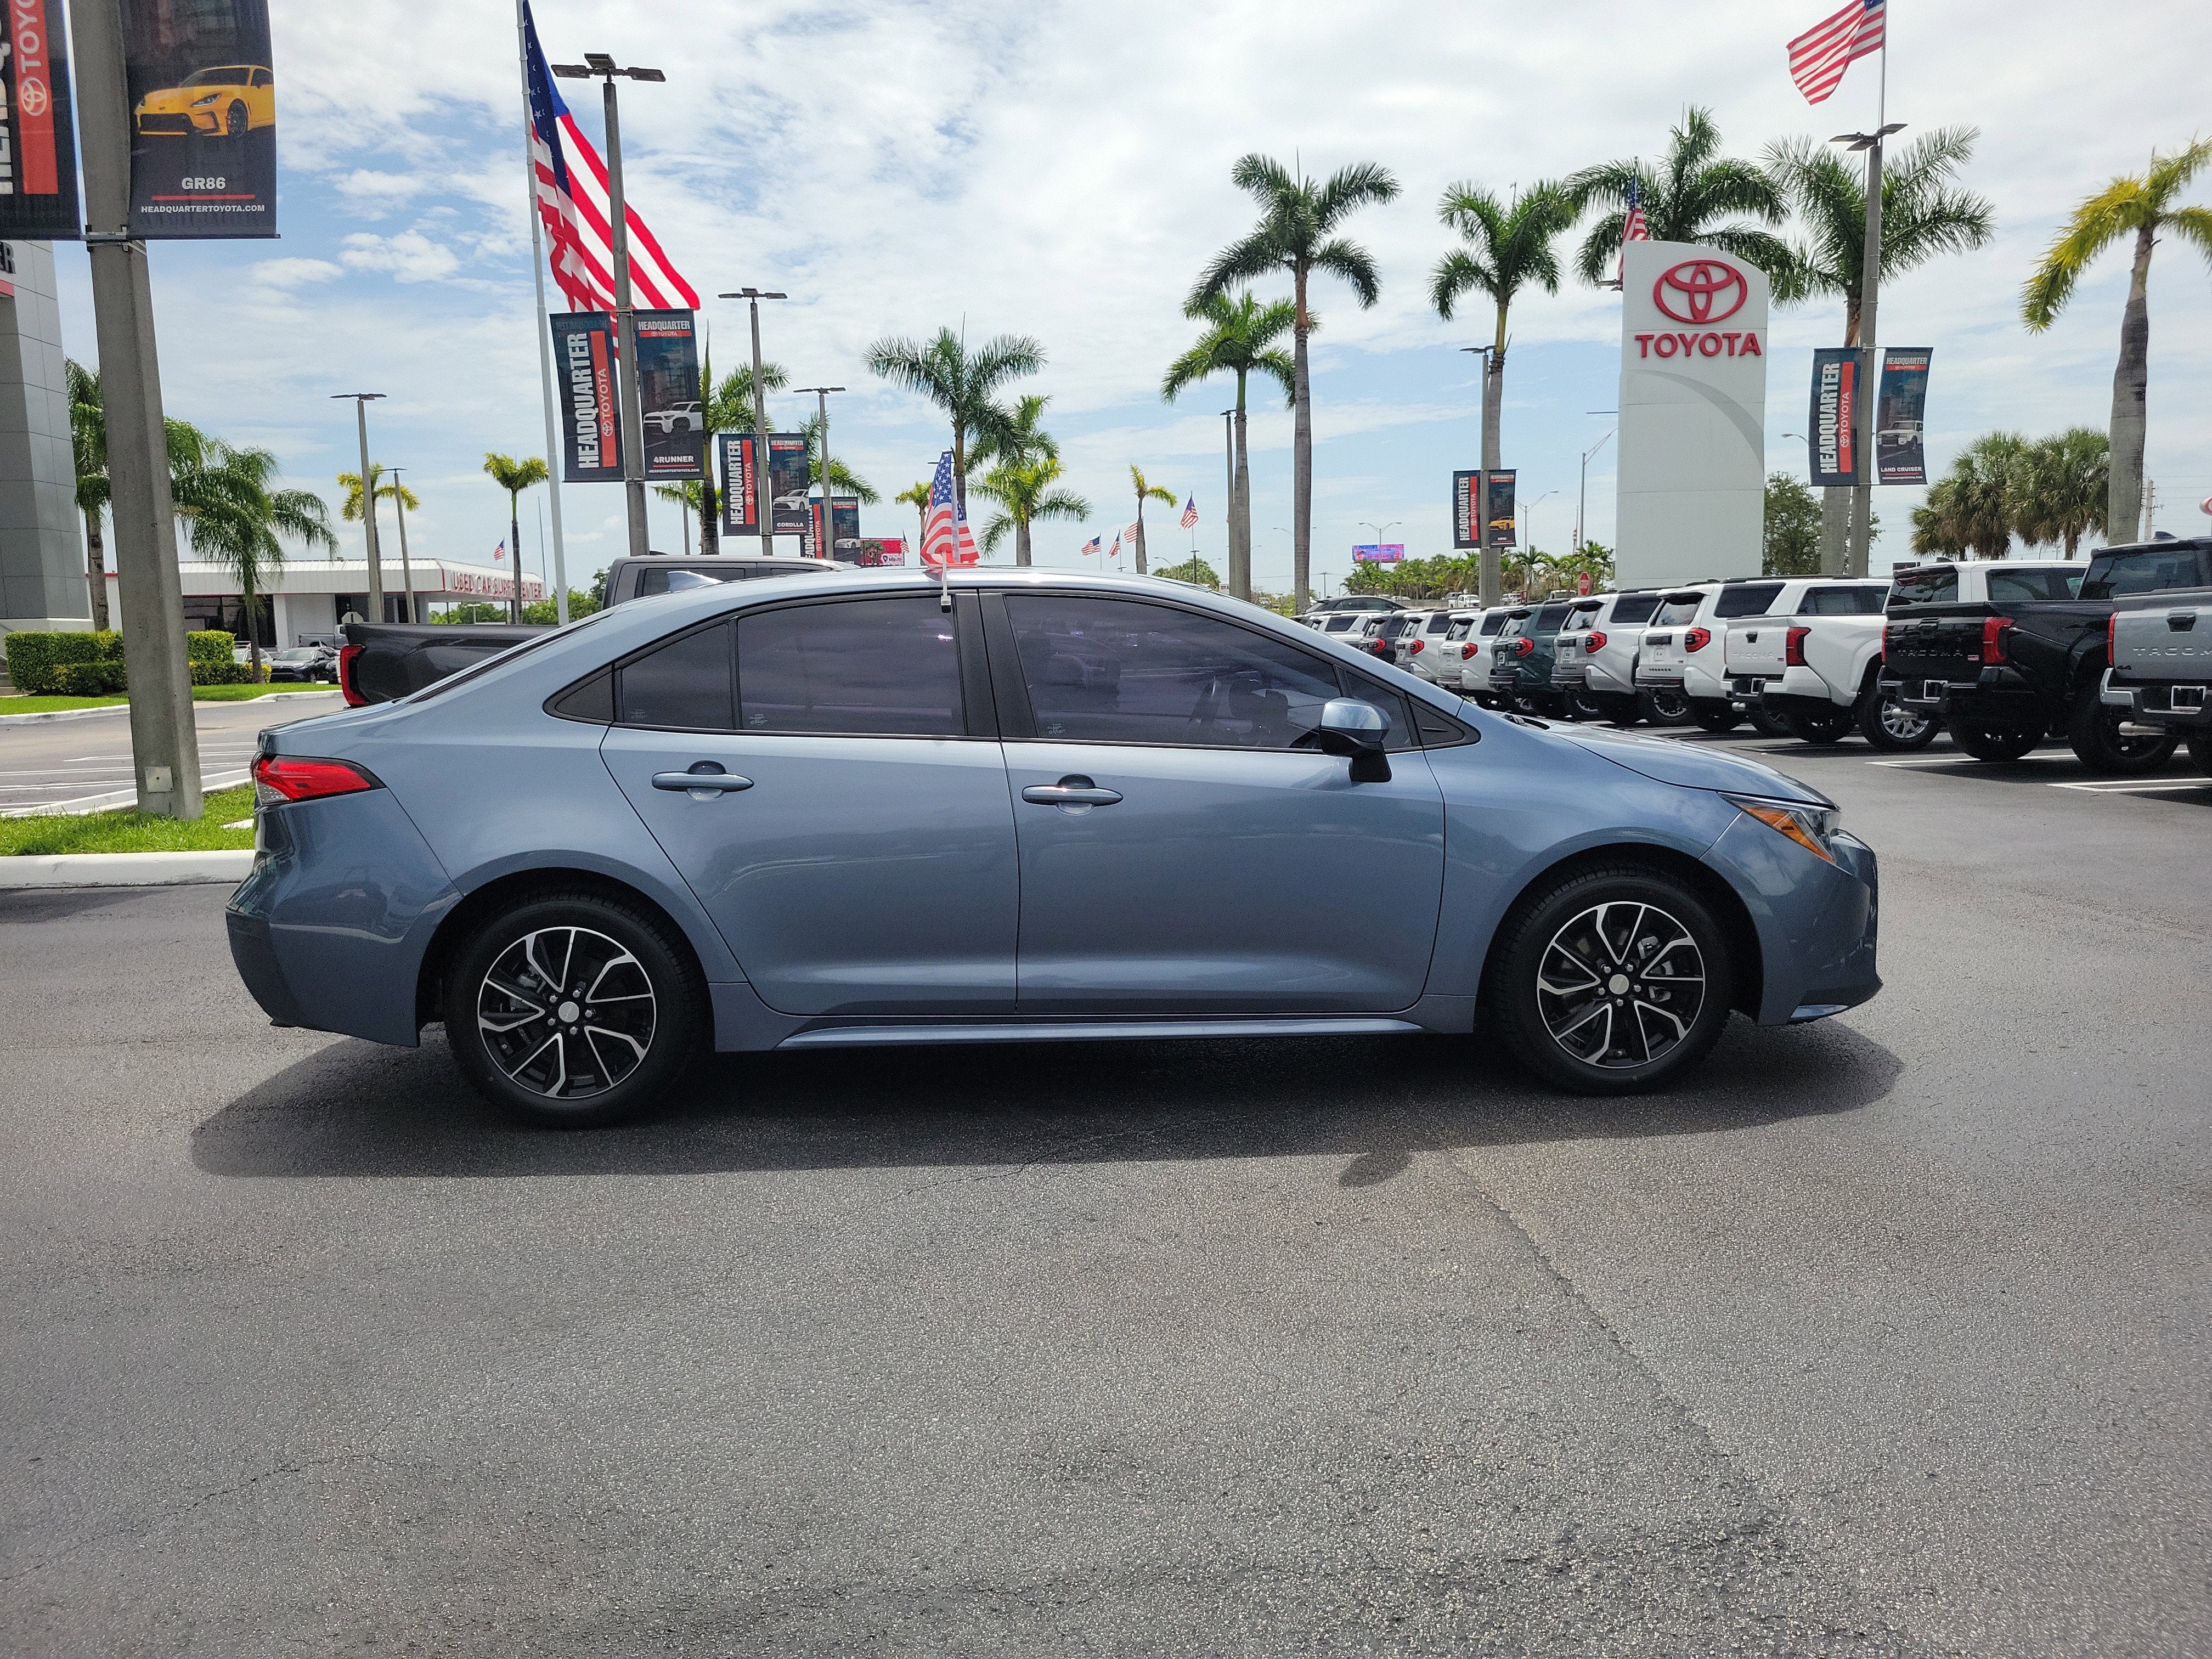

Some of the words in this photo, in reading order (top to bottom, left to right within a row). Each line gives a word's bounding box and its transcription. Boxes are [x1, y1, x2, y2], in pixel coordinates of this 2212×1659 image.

[182, 177, 226, 190] GR86
[141, 205, 265, 213] HEADQUARTERTOYOTA.COM
[638, 320, 691, 331] HEADQUARTER
[1634, 332, 1762, 358] TOYOTA
[1886, 357, 1927, 365] HEADQUARTER
[567, 332, 600, 469] HEADQUARTER
[597, 368, 611, 420] TOYOTA
[1819, 363, 1840, 473] HEADQUARTER
[1841, 392, 1850, 434] TOYOTA
[727, 440, 745, 525] HEADQUARTER
[1458, 477, 1470, 541] HEADQUARTER
[452, 572, 475, 592] USED
[475, 575, 492, 594] CAR
